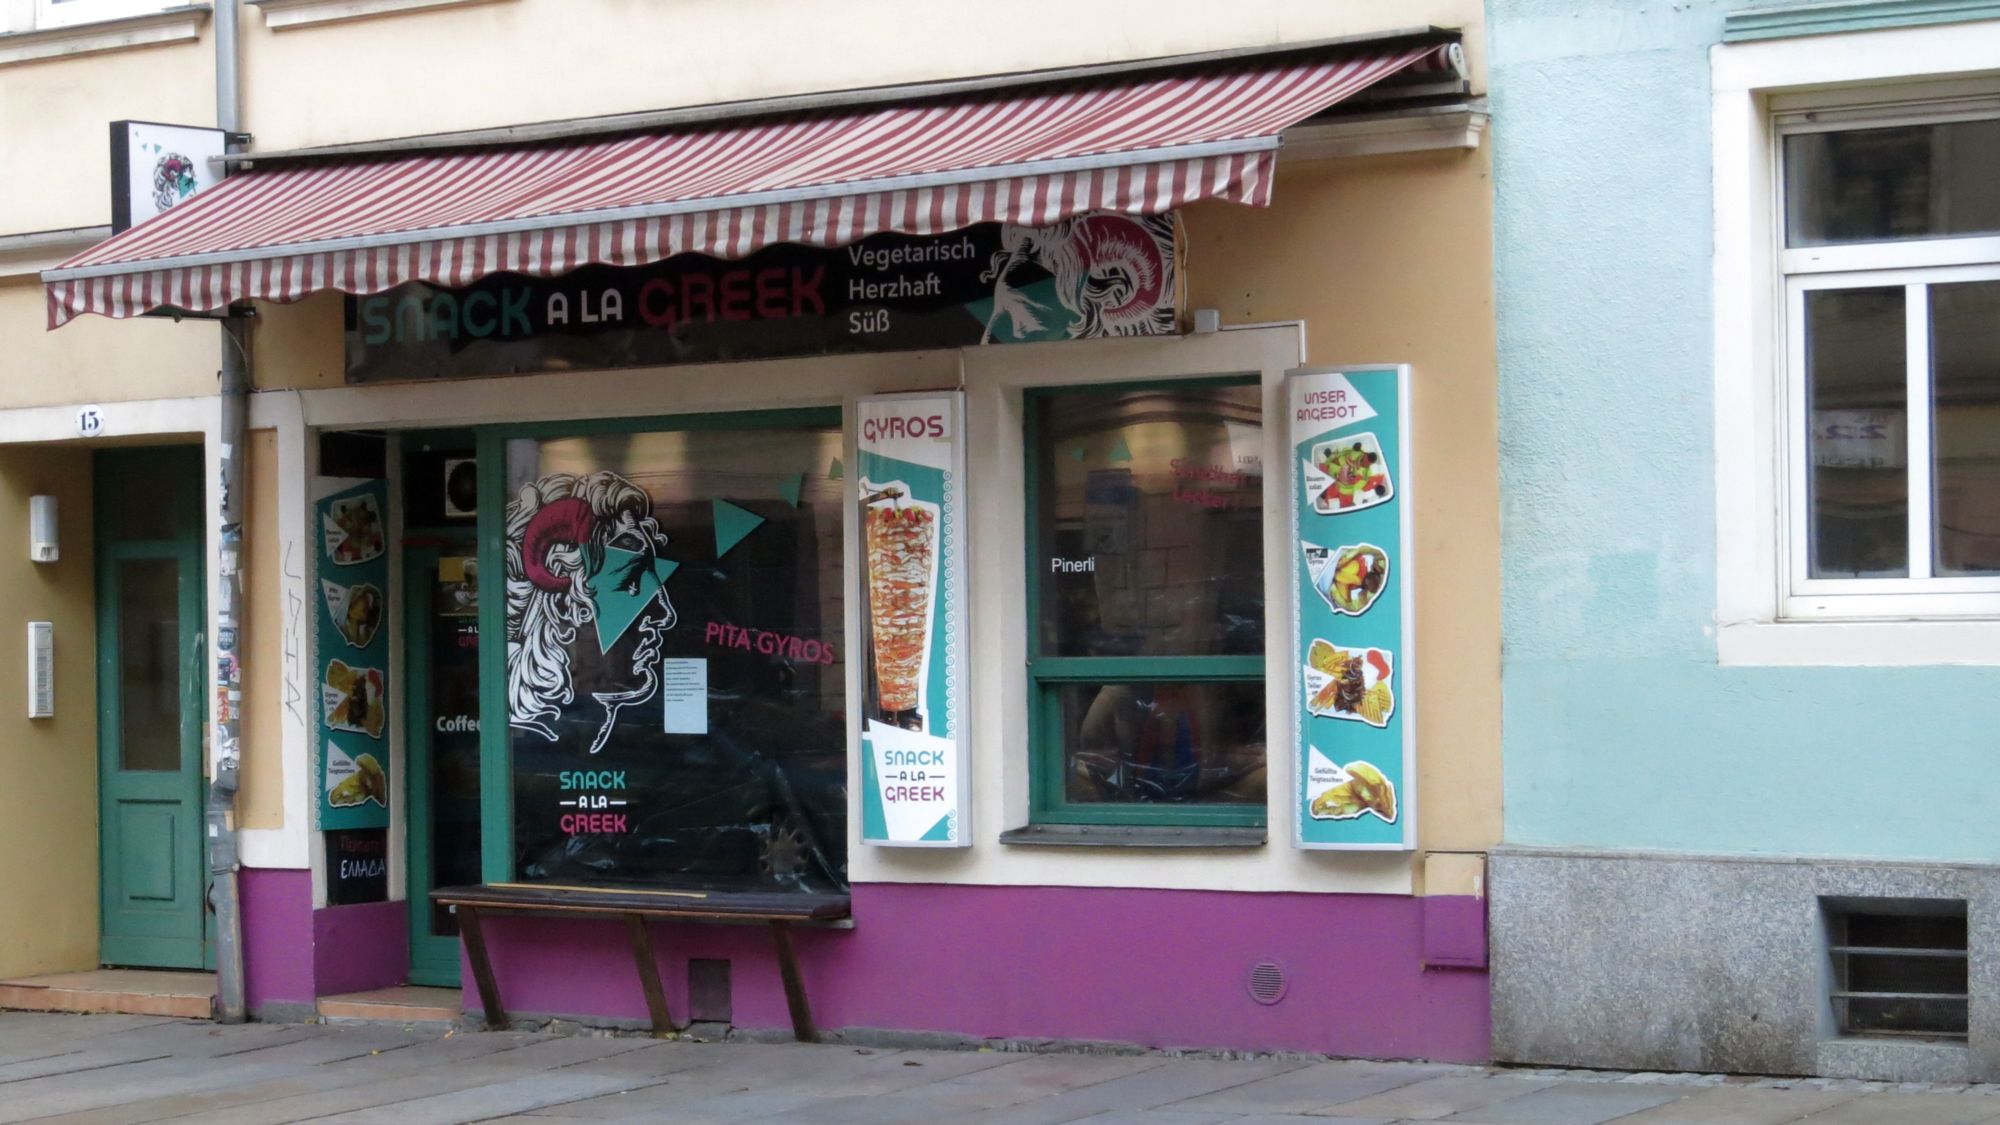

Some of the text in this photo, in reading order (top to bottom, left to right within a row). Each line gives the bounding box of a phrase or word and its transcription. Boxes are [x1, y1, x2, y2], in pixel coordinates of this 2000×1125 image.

[850, 237, 976, 271] Vegetarisch
[850, 273, 942, 300] Herzhaft
[363, 266, 827, 344] SNACK A LA GREEK
[850, 310, 891, 334] Süß
[1304, 390, 1346, 404] UNSER
[82, 411, 100, 430] 15
[1297, 405, 1358, 421] ANGEBOT
[863, 415, 944, 443] GYROS
[1051, 556, 1095, 572] Pinerli
[705, 622, 834, 665] PITA GYROS
[884, 750, 944, 765] SNACK
[560, 770, 626, 789] SNACK
[900, 770, 926, 781] A LA
[579, 795, 607, 809] A LA
[885, 786, 945, 804] GREEK
[560, 813, 627, 836] GREEK
